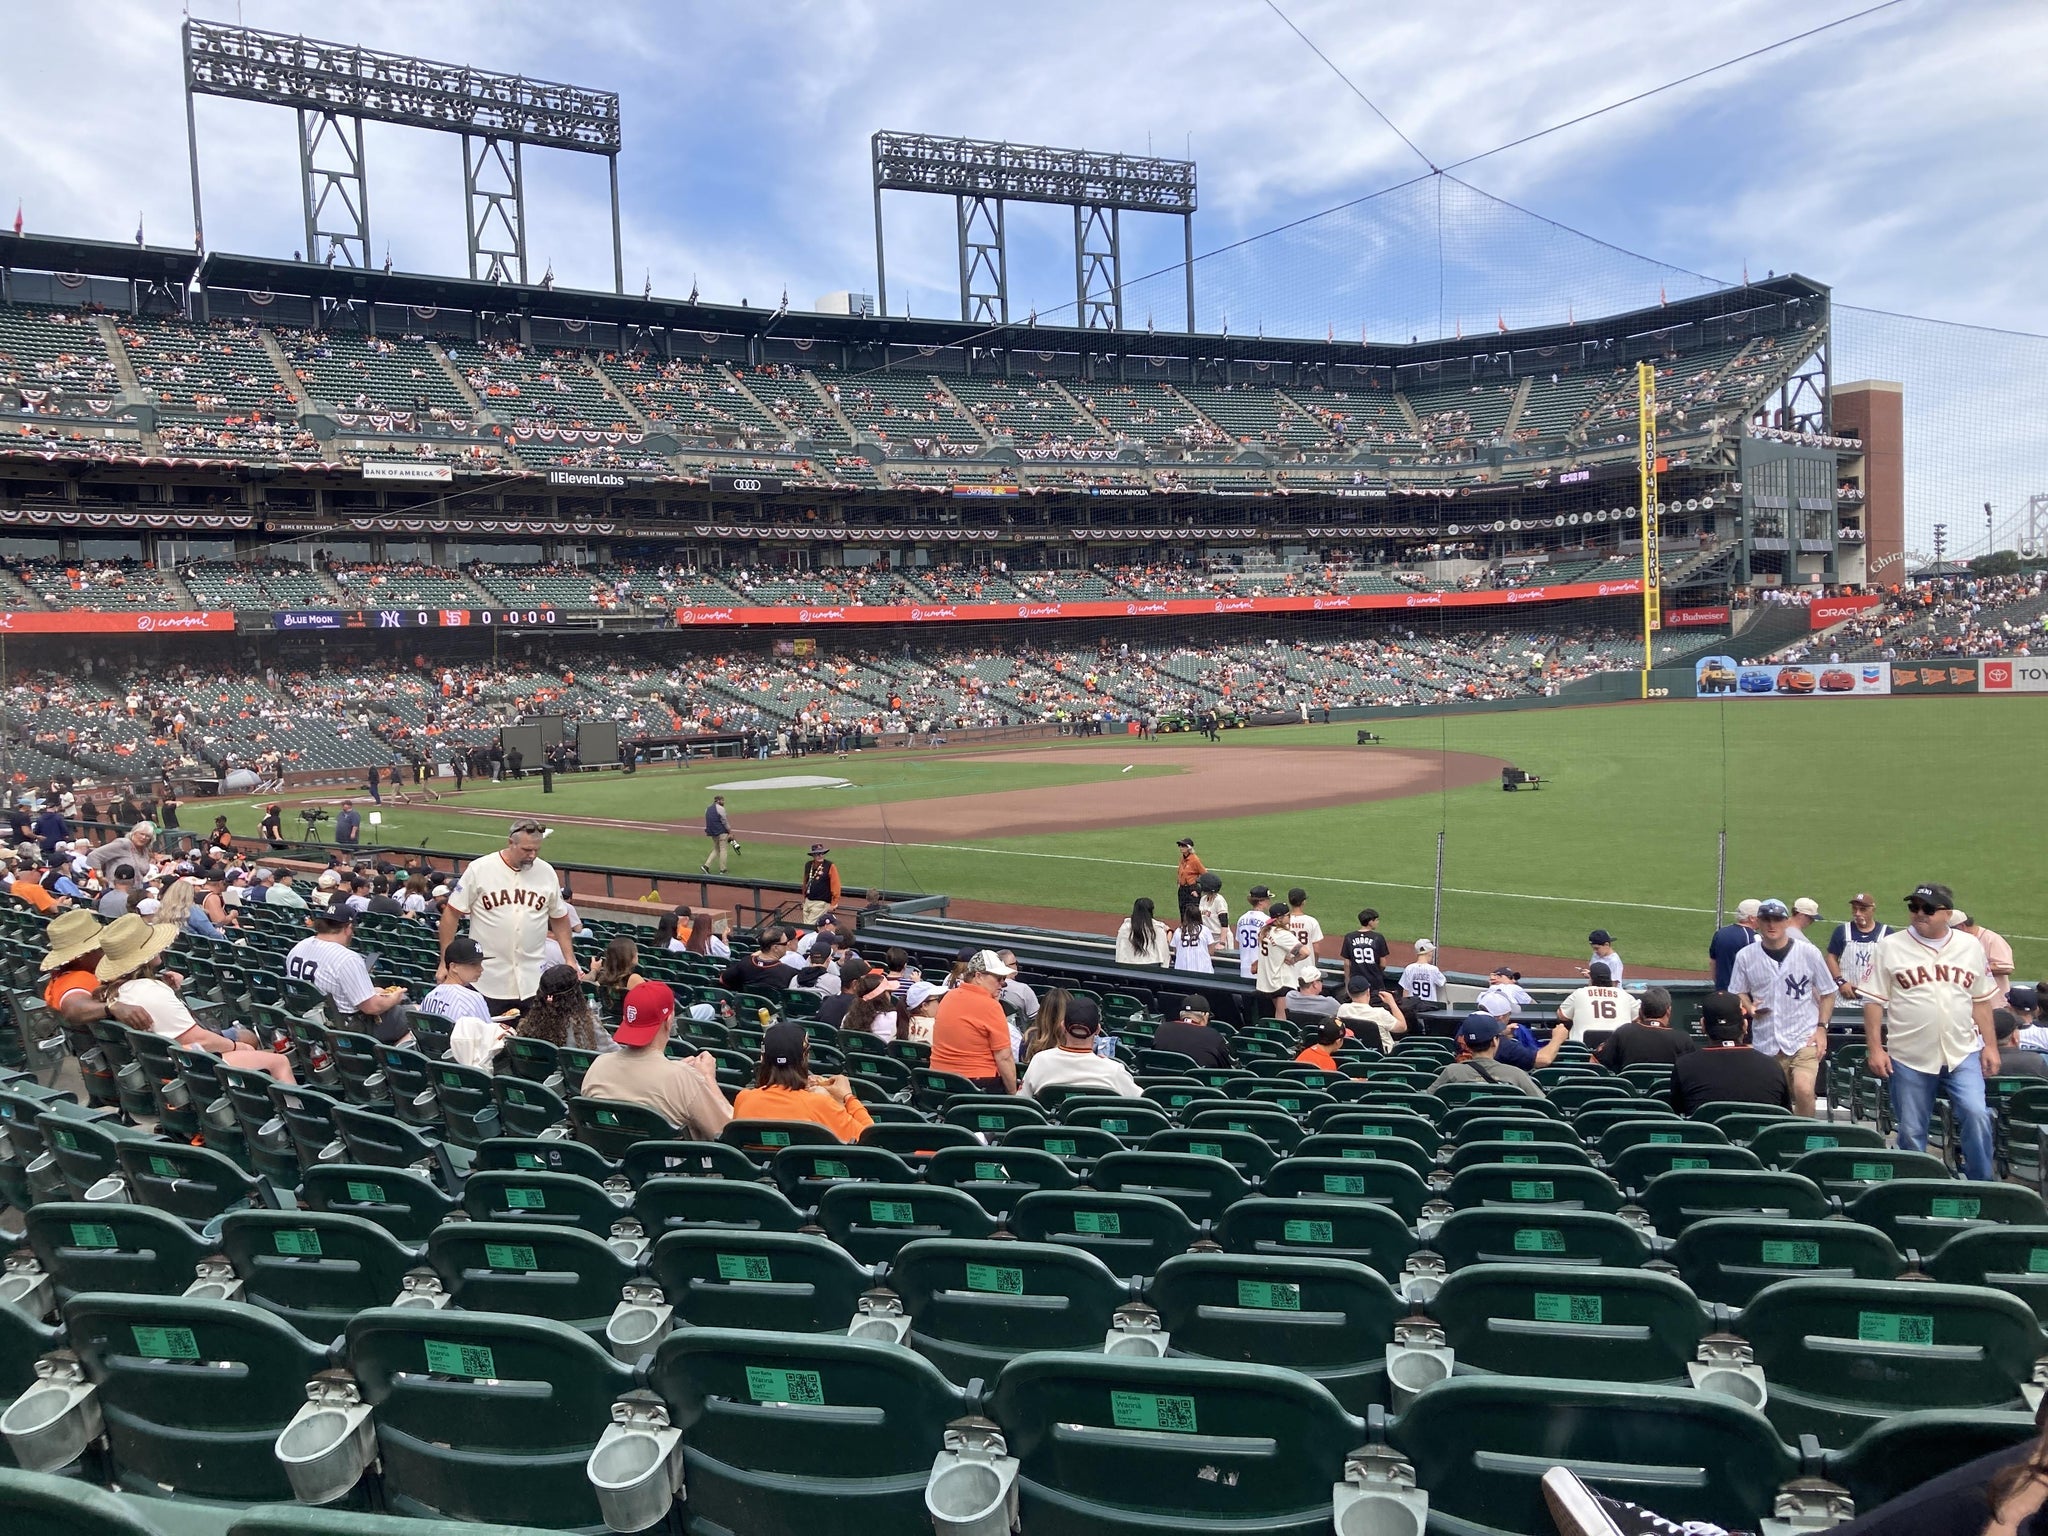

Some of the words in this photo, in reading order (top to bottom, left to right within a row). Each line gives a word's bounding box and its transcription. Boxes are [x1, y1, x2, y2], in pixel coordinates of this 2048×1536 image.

[1645, 432, 1653, 469] ROOT
[1578, 471, 1590, 481] PM
[1646, 477, 1655, 488] 4
[1647, 494, 1655, 524] THA
[1648, 530, 1657, 587] CHIKIN
[1870, 549, 1936, 573] Ghirardelli
[284, 614, 306, 625] BLUE
[309, 615, 333, 624] MOON
[418, 612, 428, 625] 0
[482, 612, 492, 624] 0
[509, 611, 519, 624] 0
[528, 611, 537, 624] 0
[546, 611, 556, 623] 0
[1682, 611, 1724, 622] Budweiser
[1648, 688, 1669, 698] 339
[482, 888, 546, 911] GIANTS
[1241, 929, 1257, 949] 35
[1352, 937, 1374, 946] JUDGE
[1353, 947, 1376, 965] 99
[1895, 963, 1976, 990] GIANTS
[1412, 981, 1431, 998] 99
[1785, 973, 1810, 1000] NY
[1588, 989, 1618, 998] DEVERS
[1591, 1000, 1617, 1019] 16
[911, 1026, 928, 1038] SEY
[751, 1376, 774, 1384] Wanna
